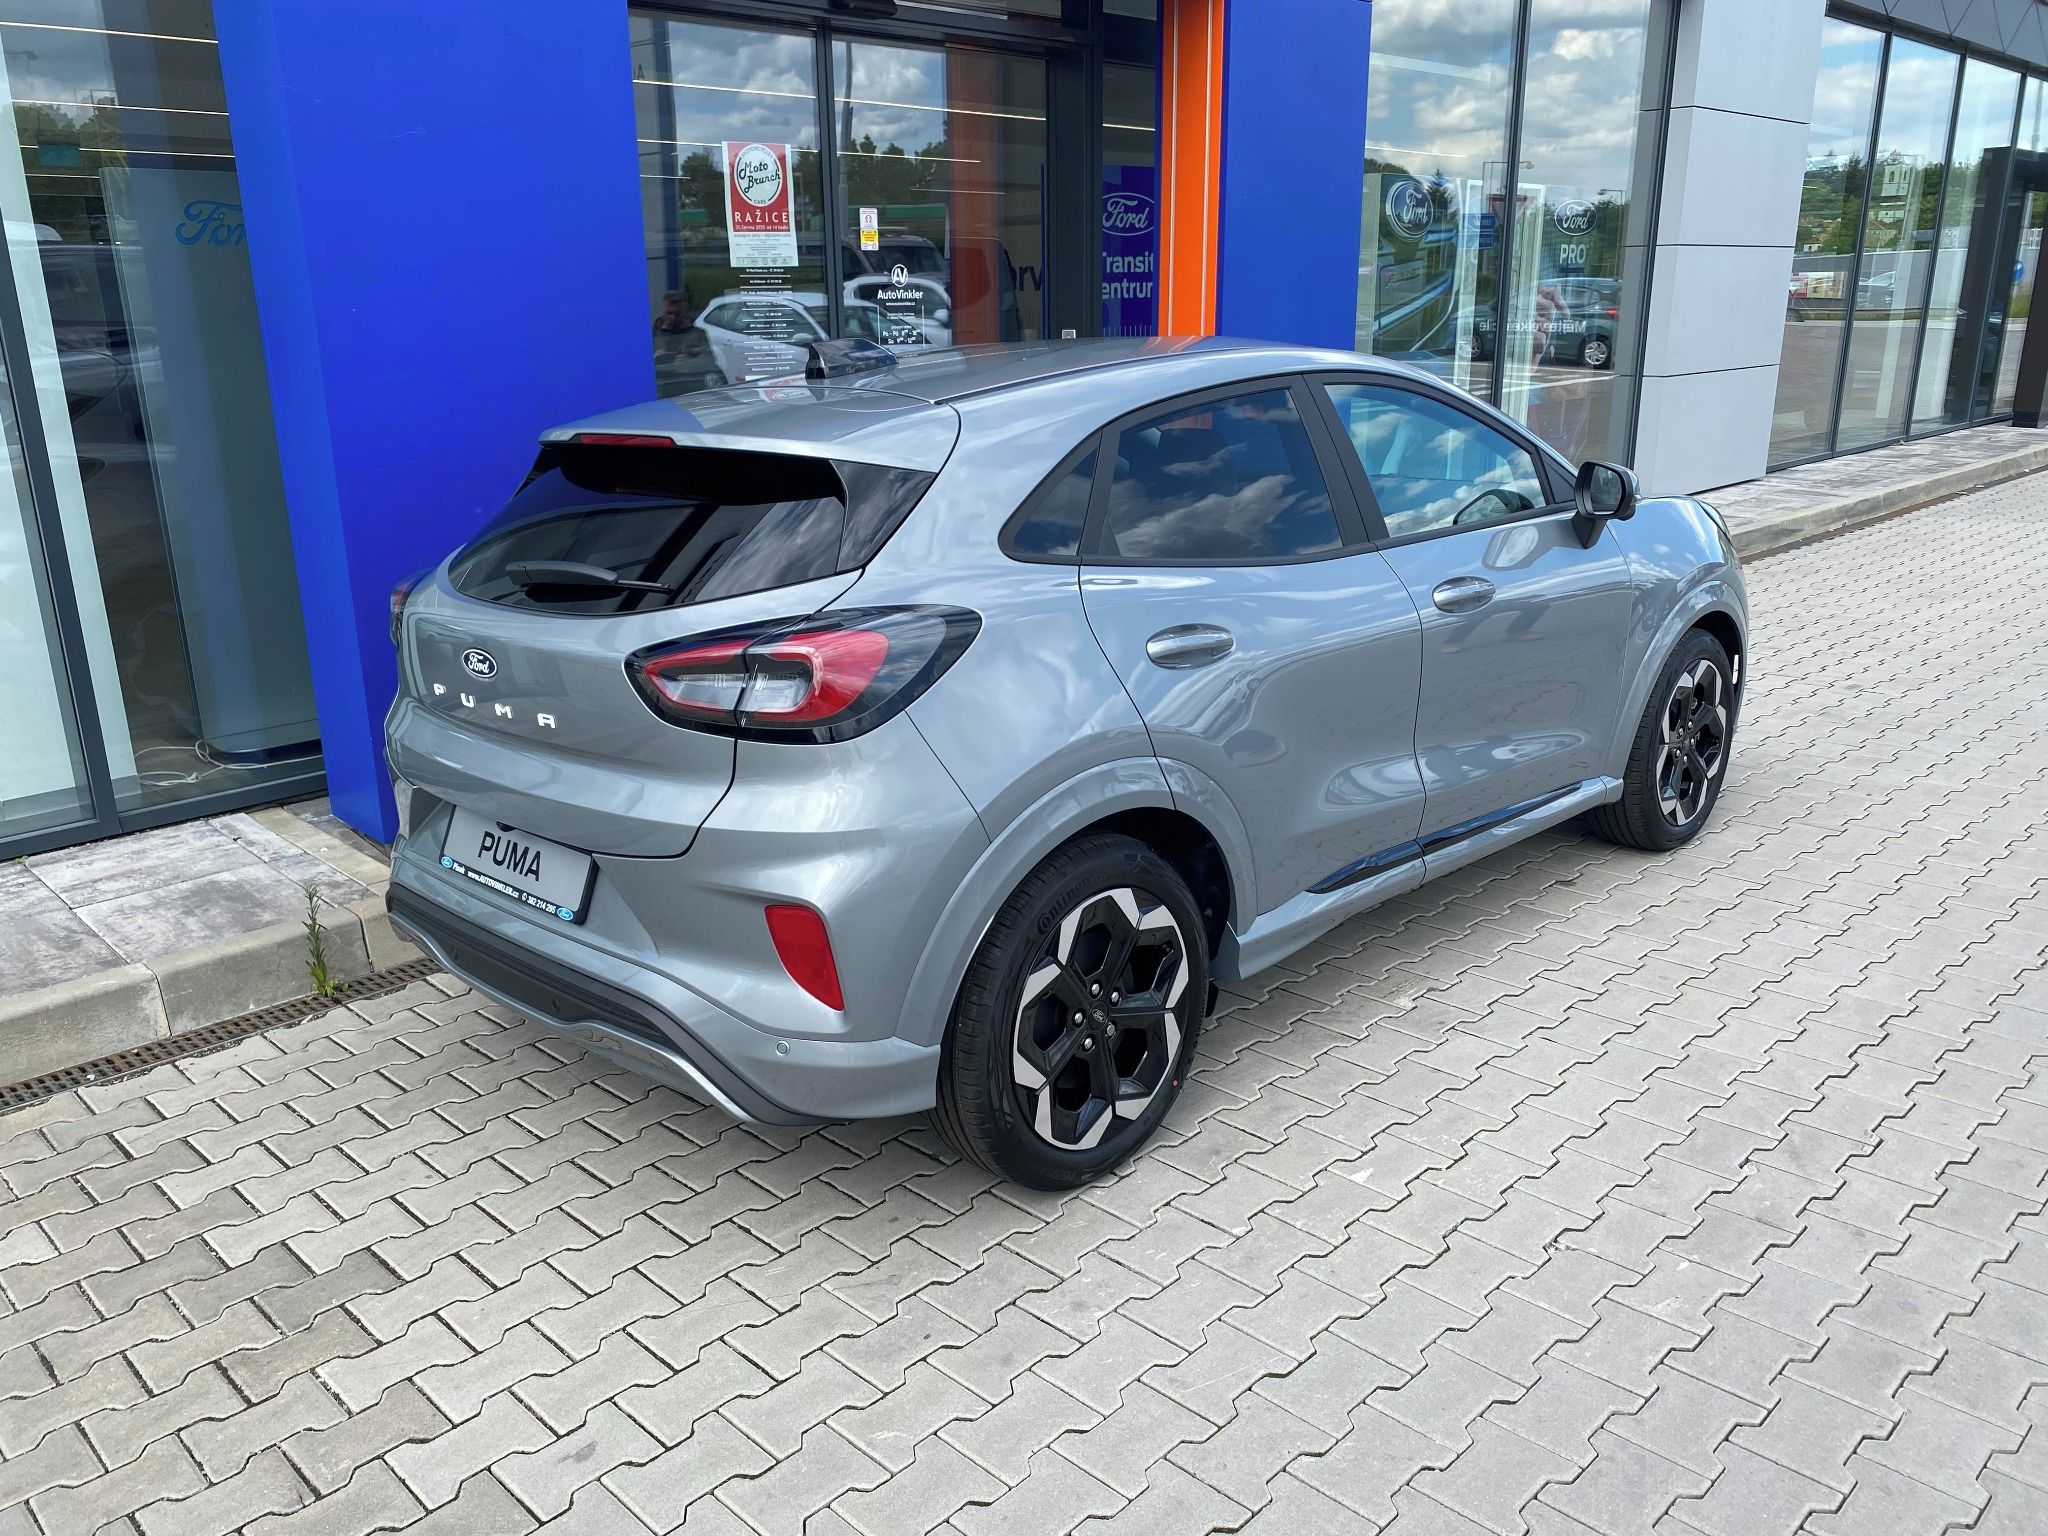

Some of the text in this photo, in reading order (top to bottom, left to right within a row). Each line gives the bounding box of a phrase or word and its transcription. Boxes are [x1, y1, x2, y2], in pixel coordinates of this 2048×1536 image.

[739, 160, 769, 180] Moto
[744, 168, 781, 194] Brunch
[734, 209, 789, 223] RAŽICE
[1102, 197, 1150, 229] Ford
[1403, 189, 1428, 224] Ford
[1562, 204, 1590, 230] Ford
[175, 200, 247, 246] For
[1102, 251, 1154, 273] ransit
[877, 289, 924, 300] AutoVinkler
[1102, 278, 1153, 300] entru
[467, 652, 490, 674] Ford
[433, 683, 557, 729] PUMA
[477, 830, 541, 883] PUMA
